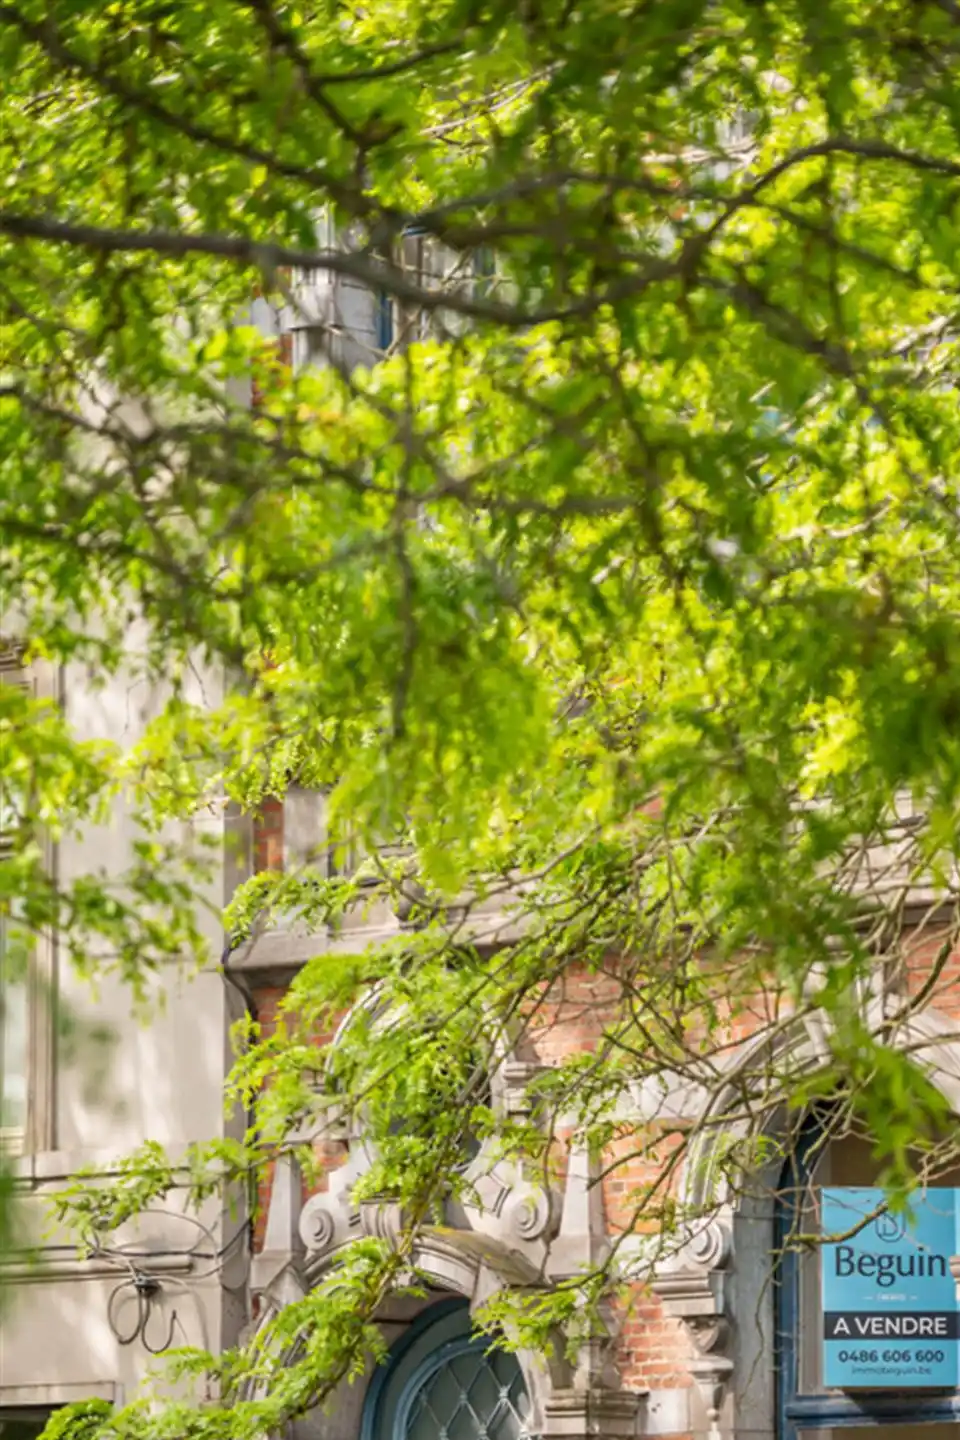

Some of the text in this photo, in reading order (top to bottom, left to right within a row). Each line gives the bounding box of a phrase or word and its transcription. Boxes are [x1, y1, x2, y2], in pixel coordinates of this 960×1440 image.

[834, 1245, 946, 1287] Beguin
[833, 1317, 948, 1335] A VENDRE
[838, 1349, 945, 1363] 0486 606 600
